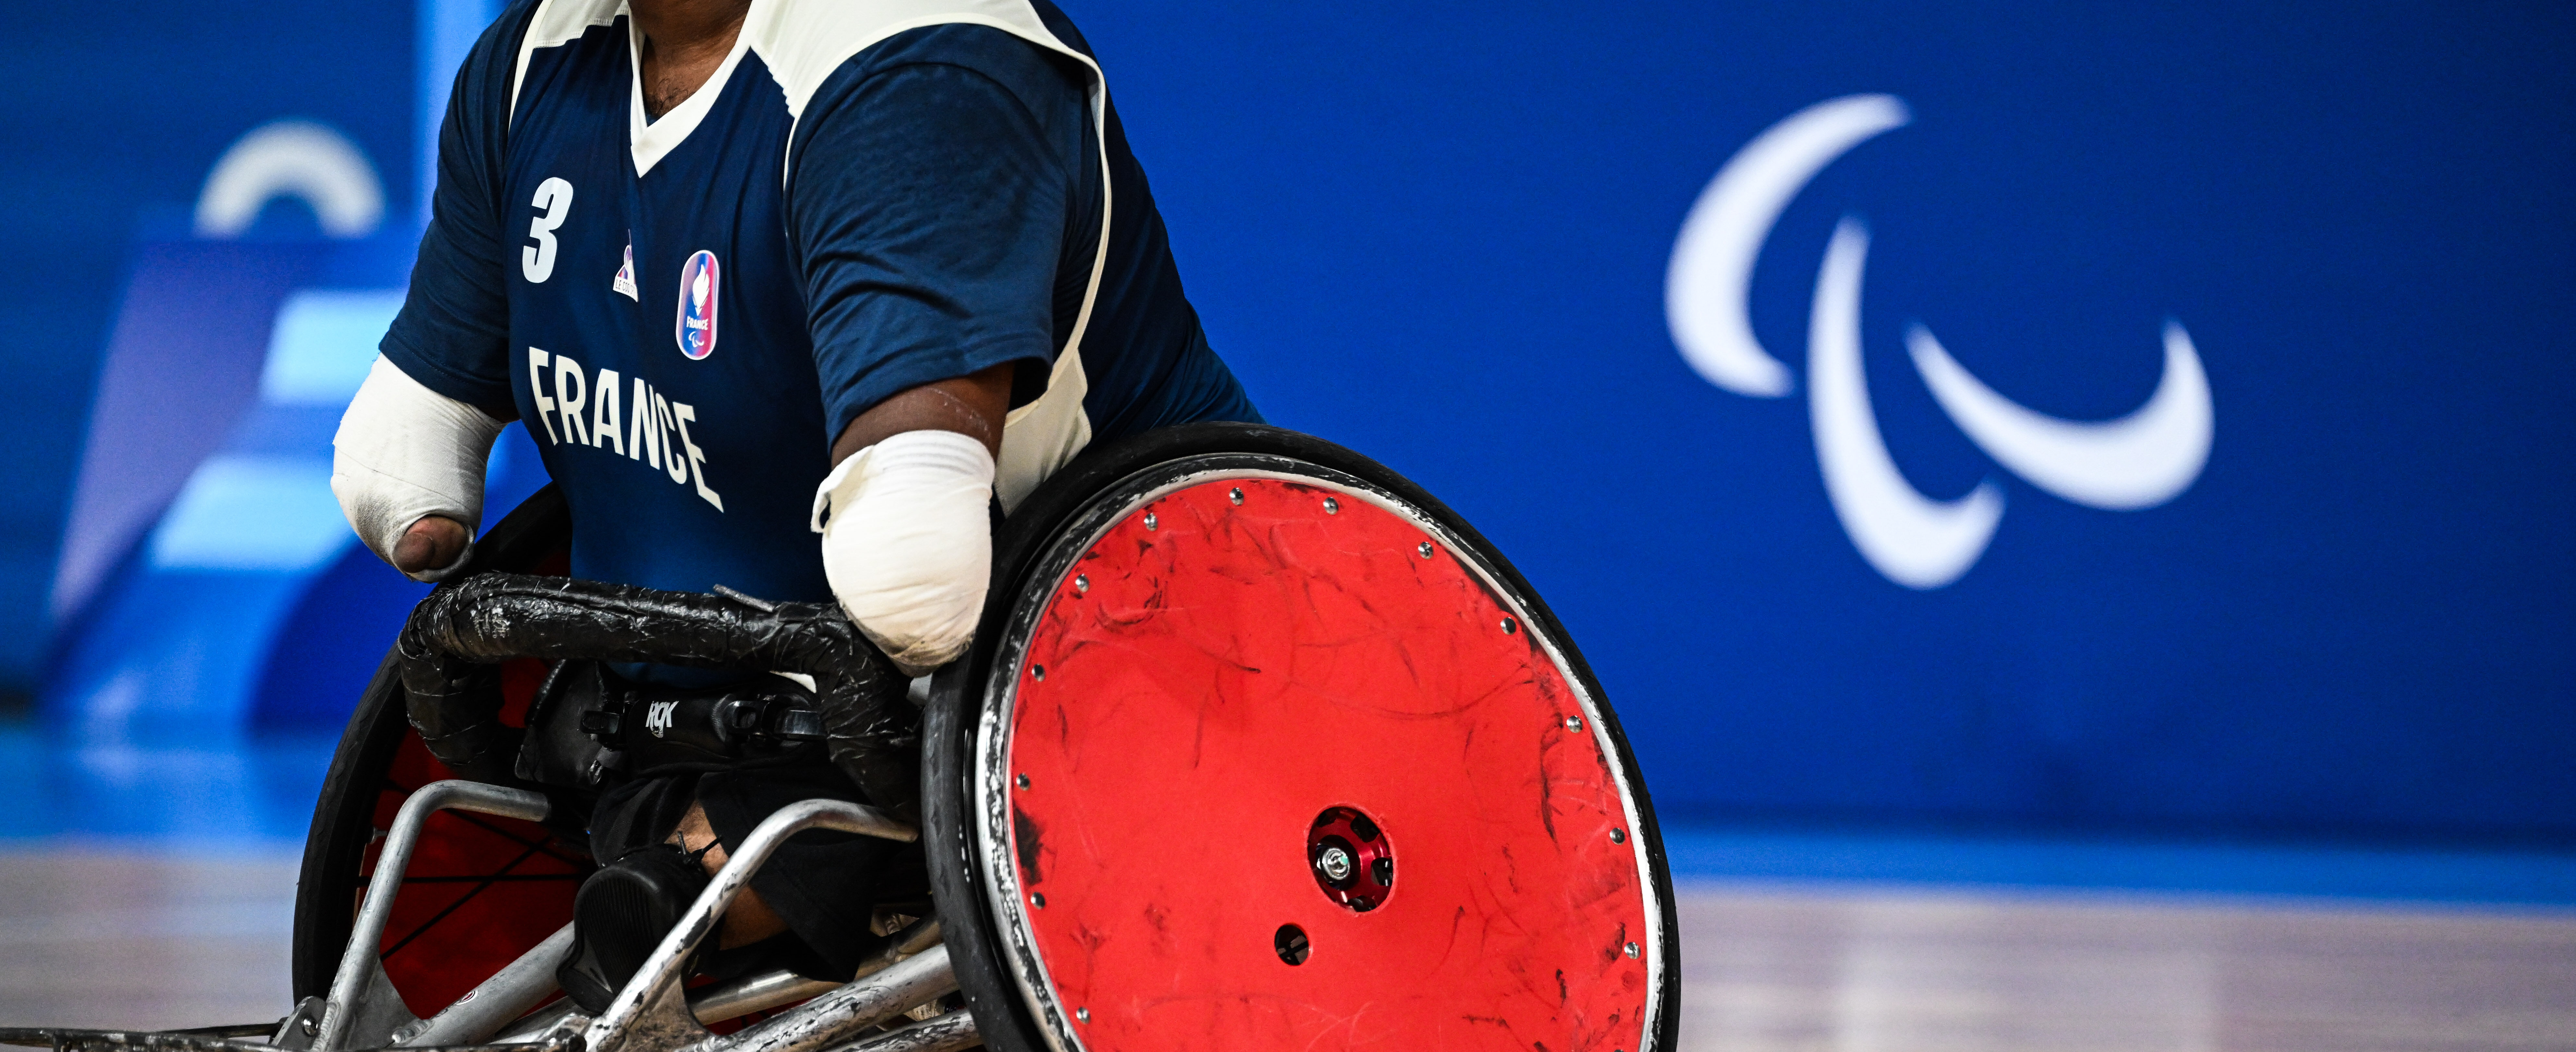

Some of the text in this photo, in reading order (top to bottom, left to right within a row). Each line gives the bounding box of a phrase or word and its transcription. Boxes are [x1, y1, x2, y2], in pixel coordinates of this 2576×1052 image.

[522, 177, 574, 283] 3
[615, 279, 621, 289] LE
[686, 315, 708, 330] FRANCE
[529, 346, 724, 513] FRANCE
